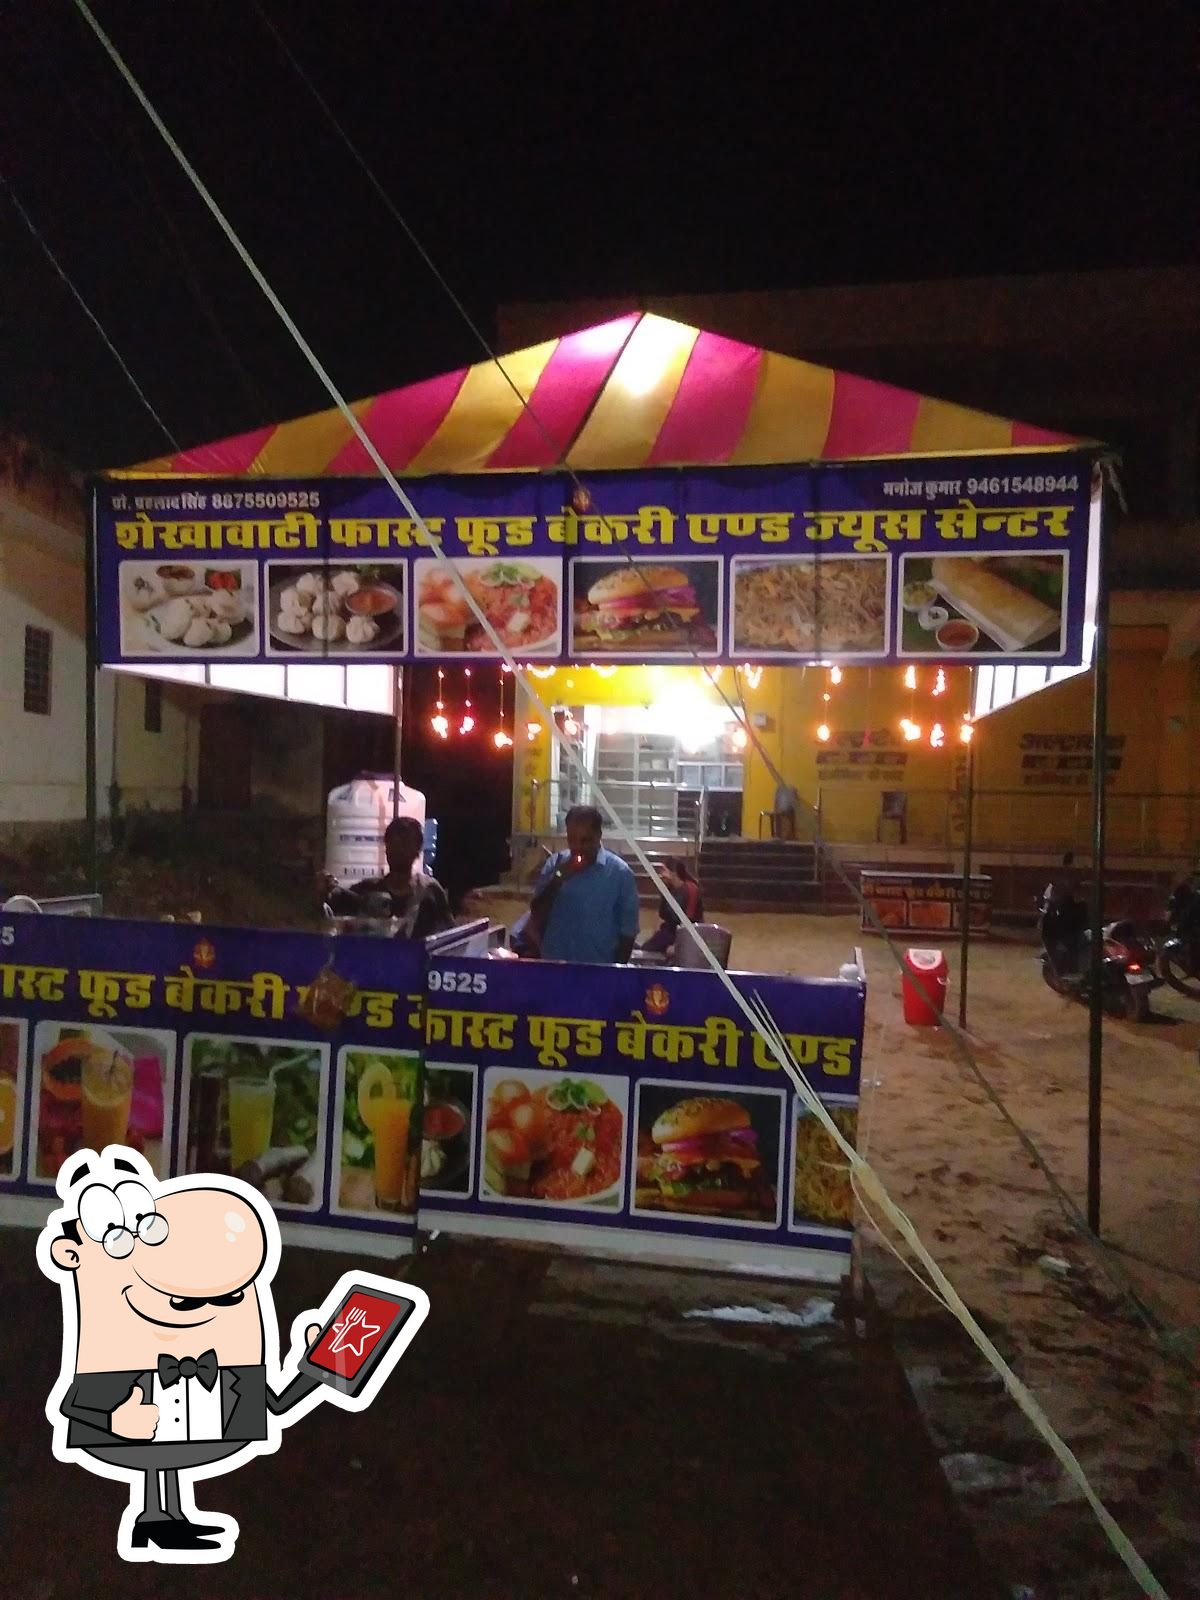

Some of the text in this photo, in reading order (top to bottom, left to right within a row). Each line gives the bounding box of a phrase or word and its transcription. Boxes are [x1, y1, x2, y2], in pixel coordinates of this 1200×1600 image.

[211, 491, 320, 510] 8875509525
[883, 475, 1079, 500] मनोज कुमार 9461548944
[115, 498, 1075, 556] शेखावाटी फास्ट फूड बेकरी एण्ड ज्यूस सेन्टर
[78, 969, 156, 1019] फूड
[164, 964, 290, 1020] बेकरी
[428, 970, 488, 994] 9525
[527, 1015, 607, 1068] फूड
[615, 1010, 744, 1068] बेकरी
[751, 1030, 857, 1077] एण्ड
